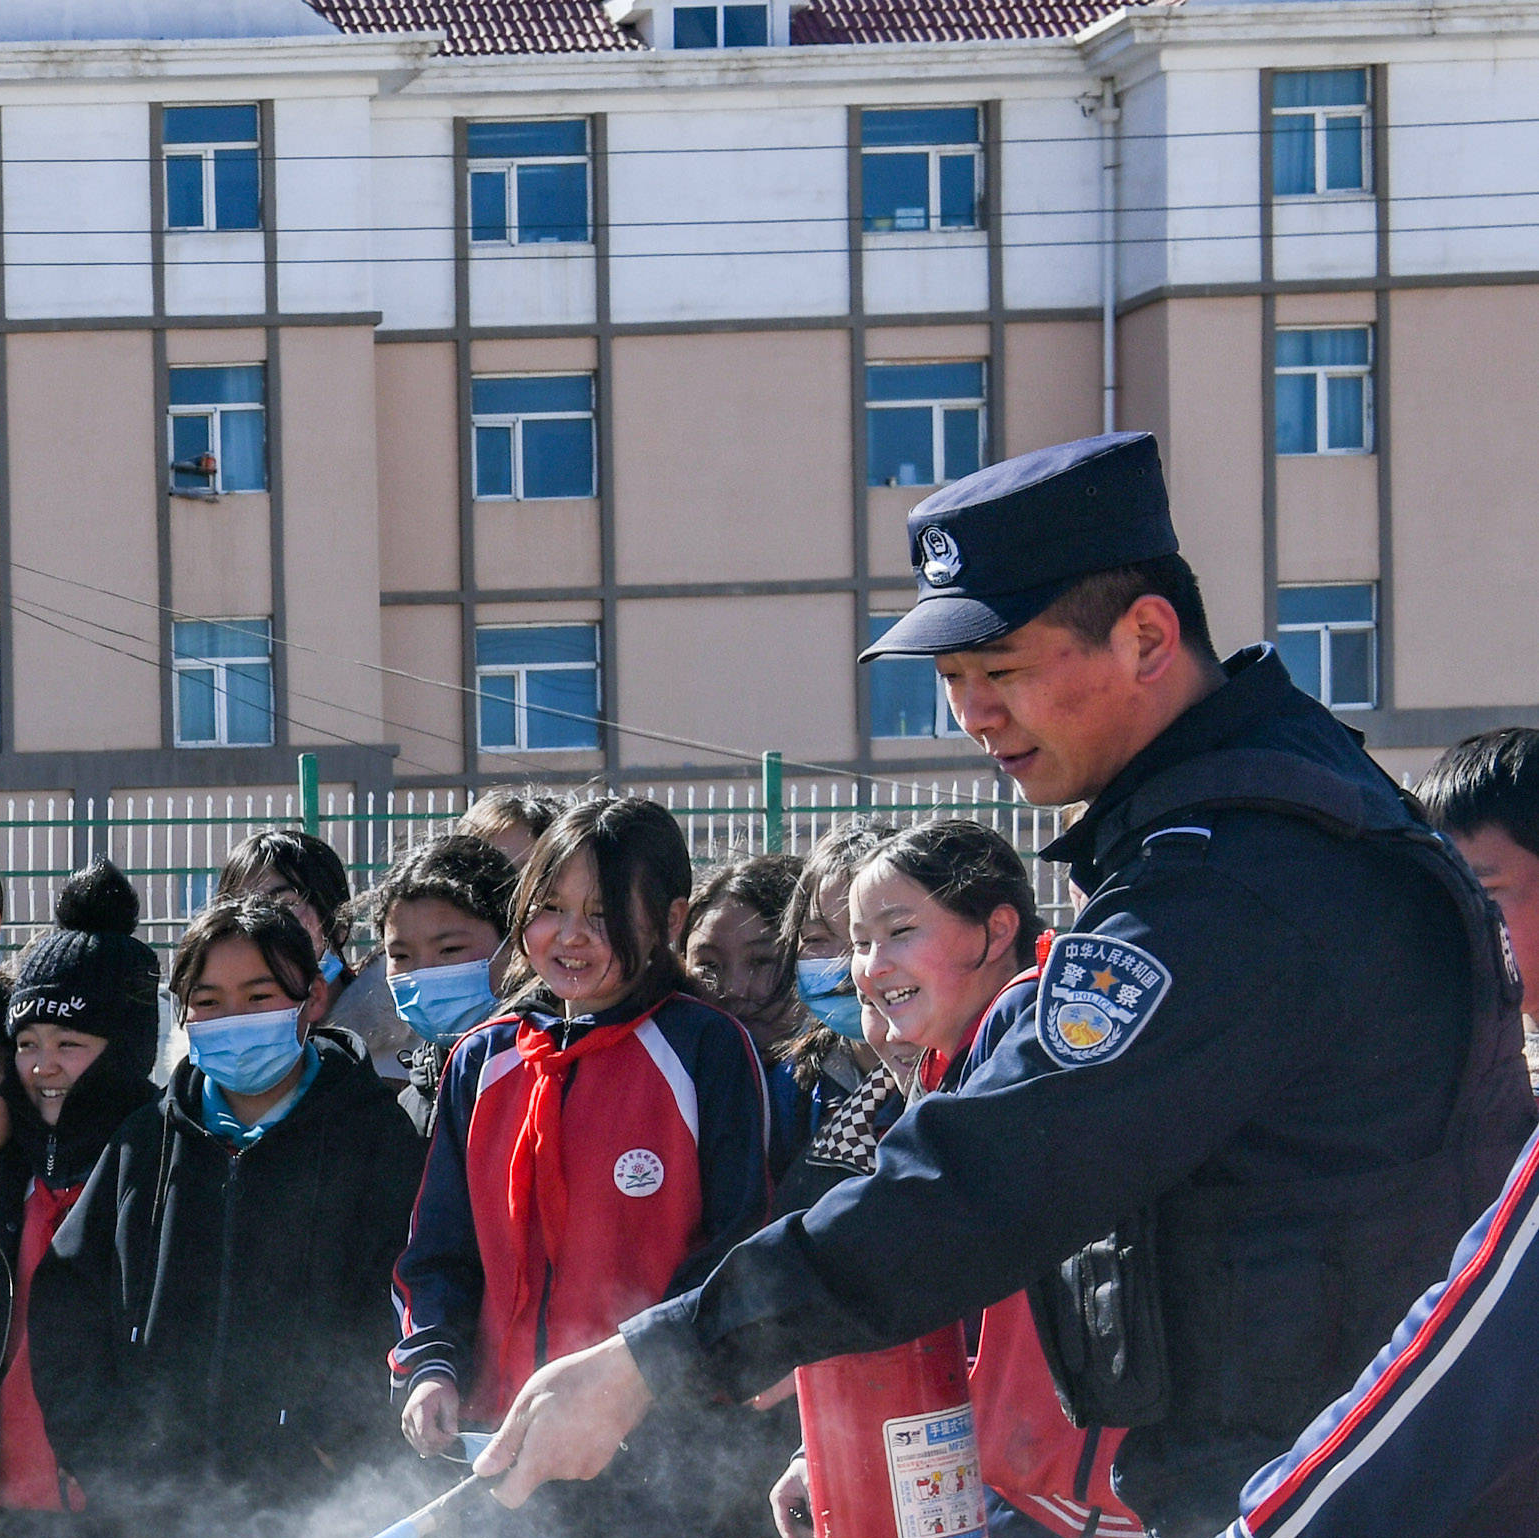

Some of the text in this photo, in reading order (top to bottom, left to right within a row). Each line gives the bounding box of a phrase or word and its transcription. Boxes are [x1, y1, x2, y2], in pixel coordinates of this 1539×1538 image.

[1060, 962, 1142, 1009] 警 察
[1065, 943, 1160, 989] 中华人民共和国
[1072, 991, 1116, 1014] POLICE
